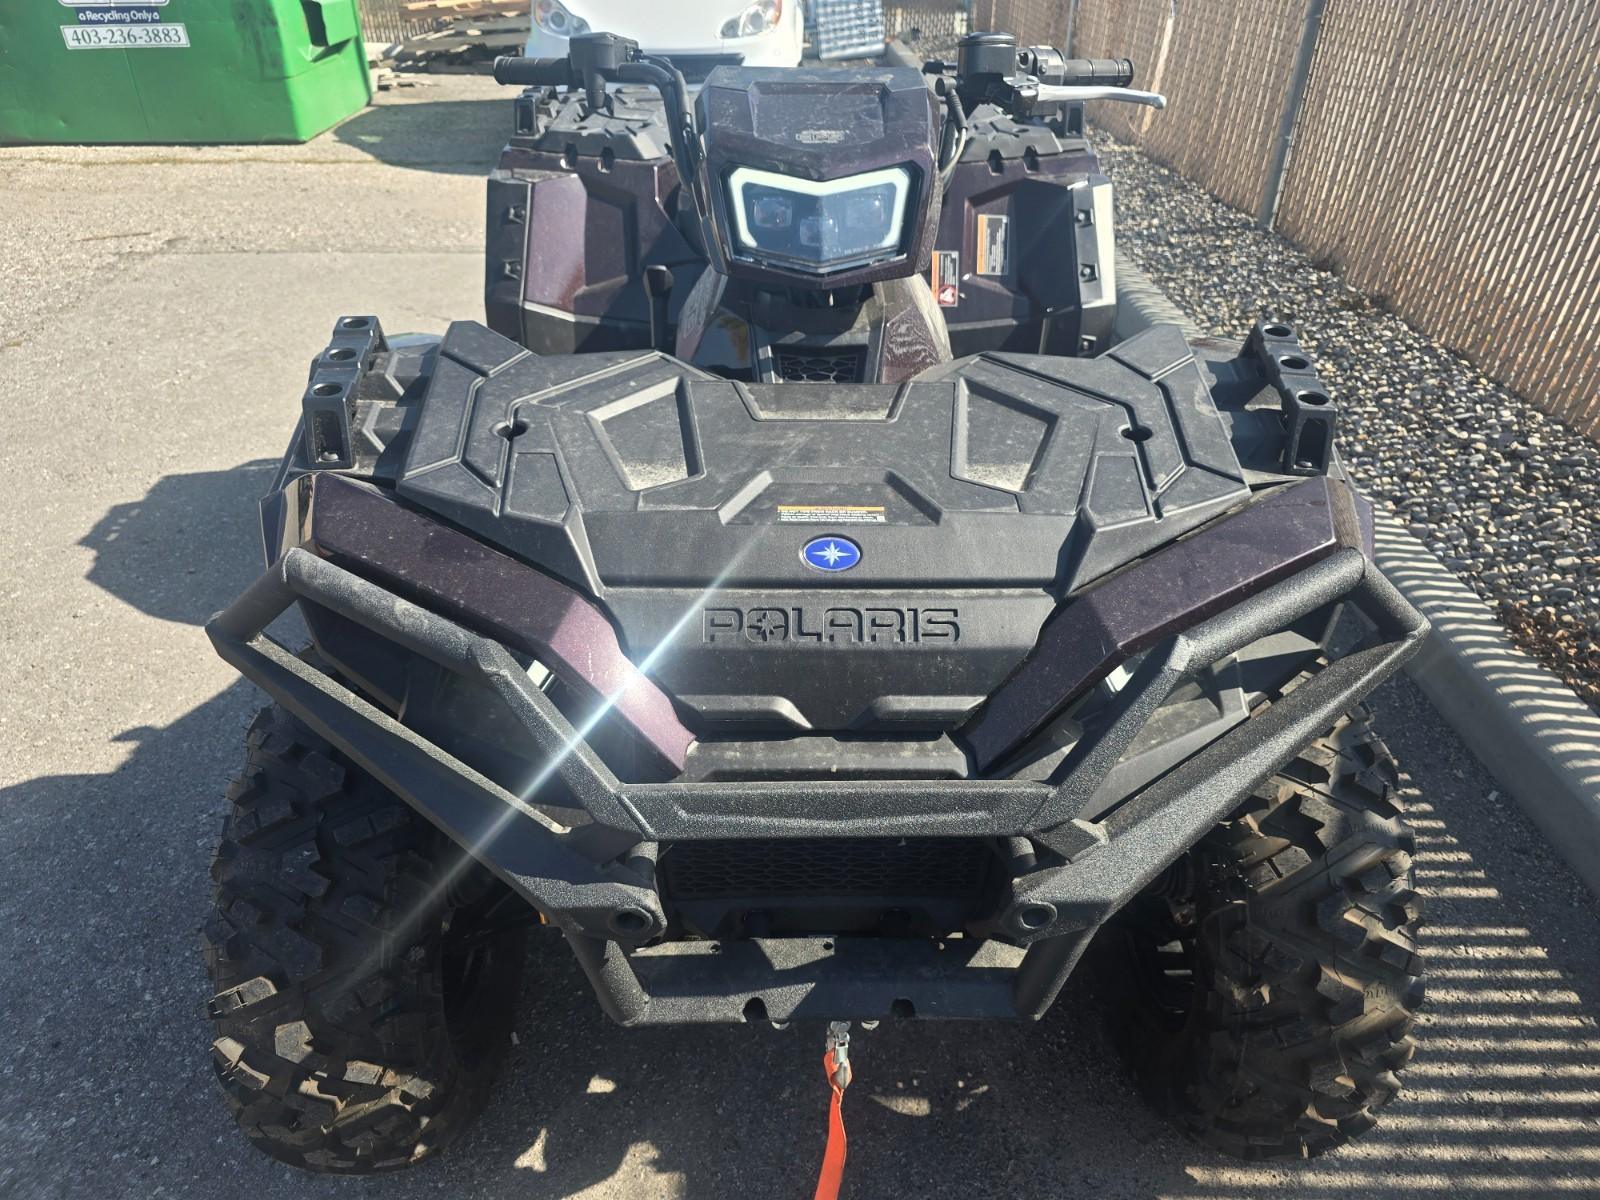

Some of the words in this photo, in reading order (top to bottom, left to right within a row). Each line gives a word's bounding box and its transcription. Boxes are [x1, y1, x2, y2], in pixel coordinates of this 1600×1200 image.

[86, 11, 130, 22] Recycling
[131, 10, 152, 21] Only
[71, 28, 181, 45] 403-236-3883
[702, 607, 960, 643] POLARIS
